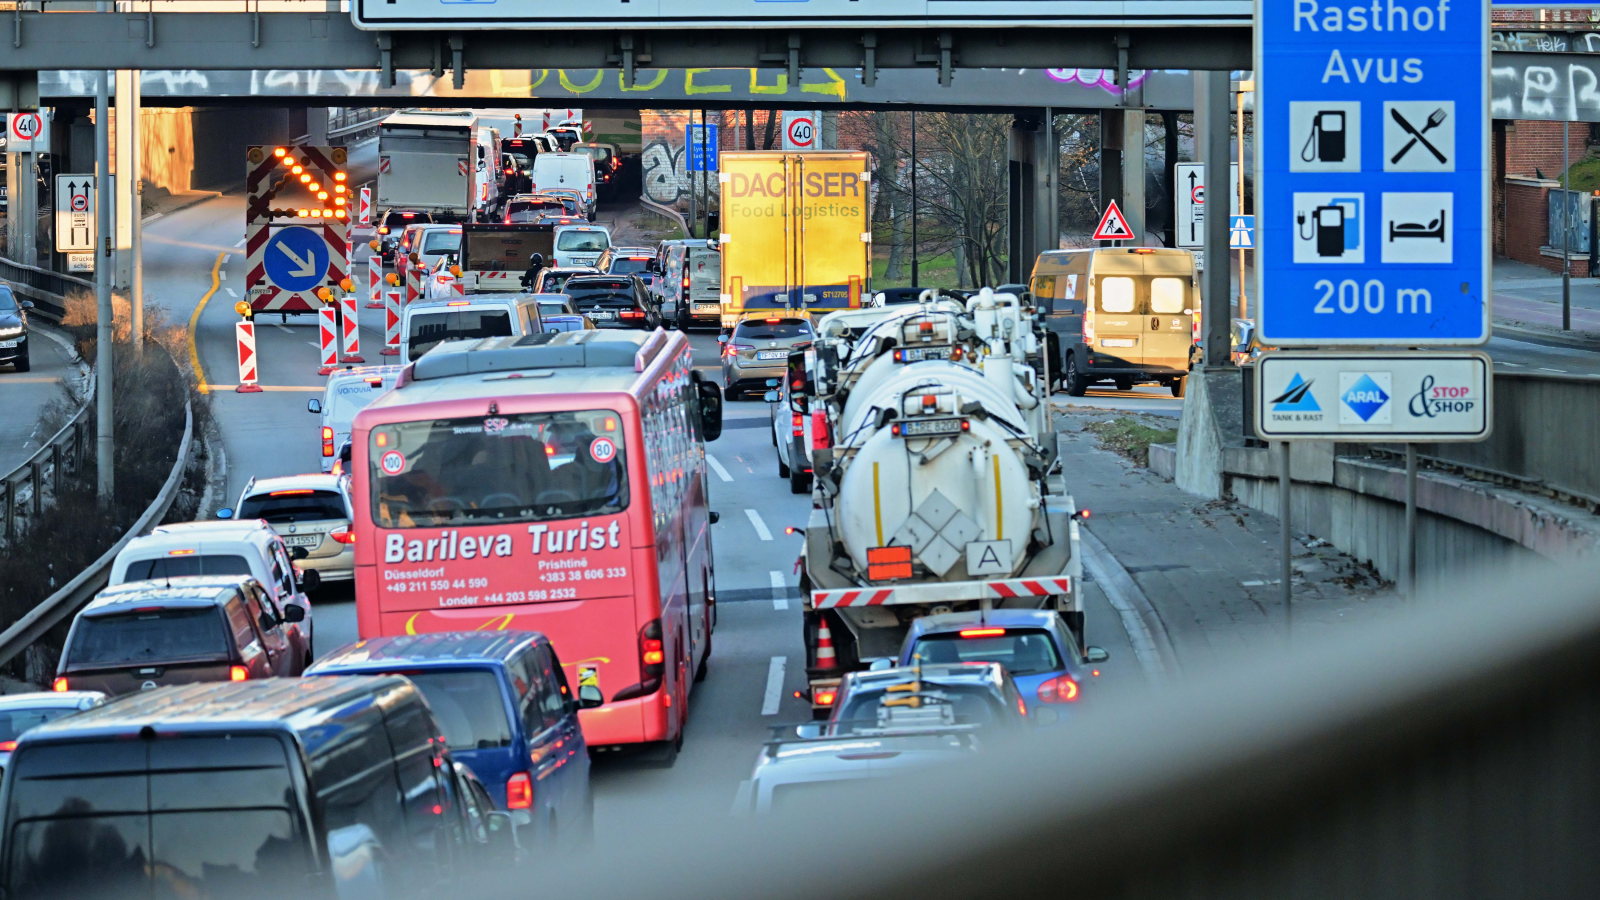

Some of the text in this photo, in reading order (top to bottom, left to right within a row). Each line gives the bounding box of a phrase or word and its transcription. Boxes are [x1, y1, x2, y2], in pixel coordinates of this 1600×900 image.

[1293, 0, 1450, 32] Rasthof
[1321, 49, 1424, 83] Avus
[793, 125, 811, 139] 40
[730, 172, 859, 198] DACHSER
[731, 203, 860, 220] Food Logistics
[822, 290, 848, 299] ST12705
[1313, 279, 1432, 314] 200 m
[1346, 391, 1384, 404] ARAL
[1432, 386, 1470, 398] STOP
[1434, 401, 1474, 413] SHOP
[484, 417, 509, 432] ESP
[908, 423, 914, 433] B
[934, 419, 959, 431] 8200
[595, 443, 610, 457] 80
[384, 456, 401, 469] 100
[296, 535, 316, 544] 1551
[384, 519, 621, 564] Barileva Turist
[977, 544, 1003, 569] A
[538, 557, 588, 571] Prishtinë
[384, 567, 445, 581] Düsseldorf
[539, 567, 627, 583] +383 38 606 333
[386, 577, 488, 592] +49 211 550 44 590
[439, 588, 576, 607] Londer +44 203 598 2532
